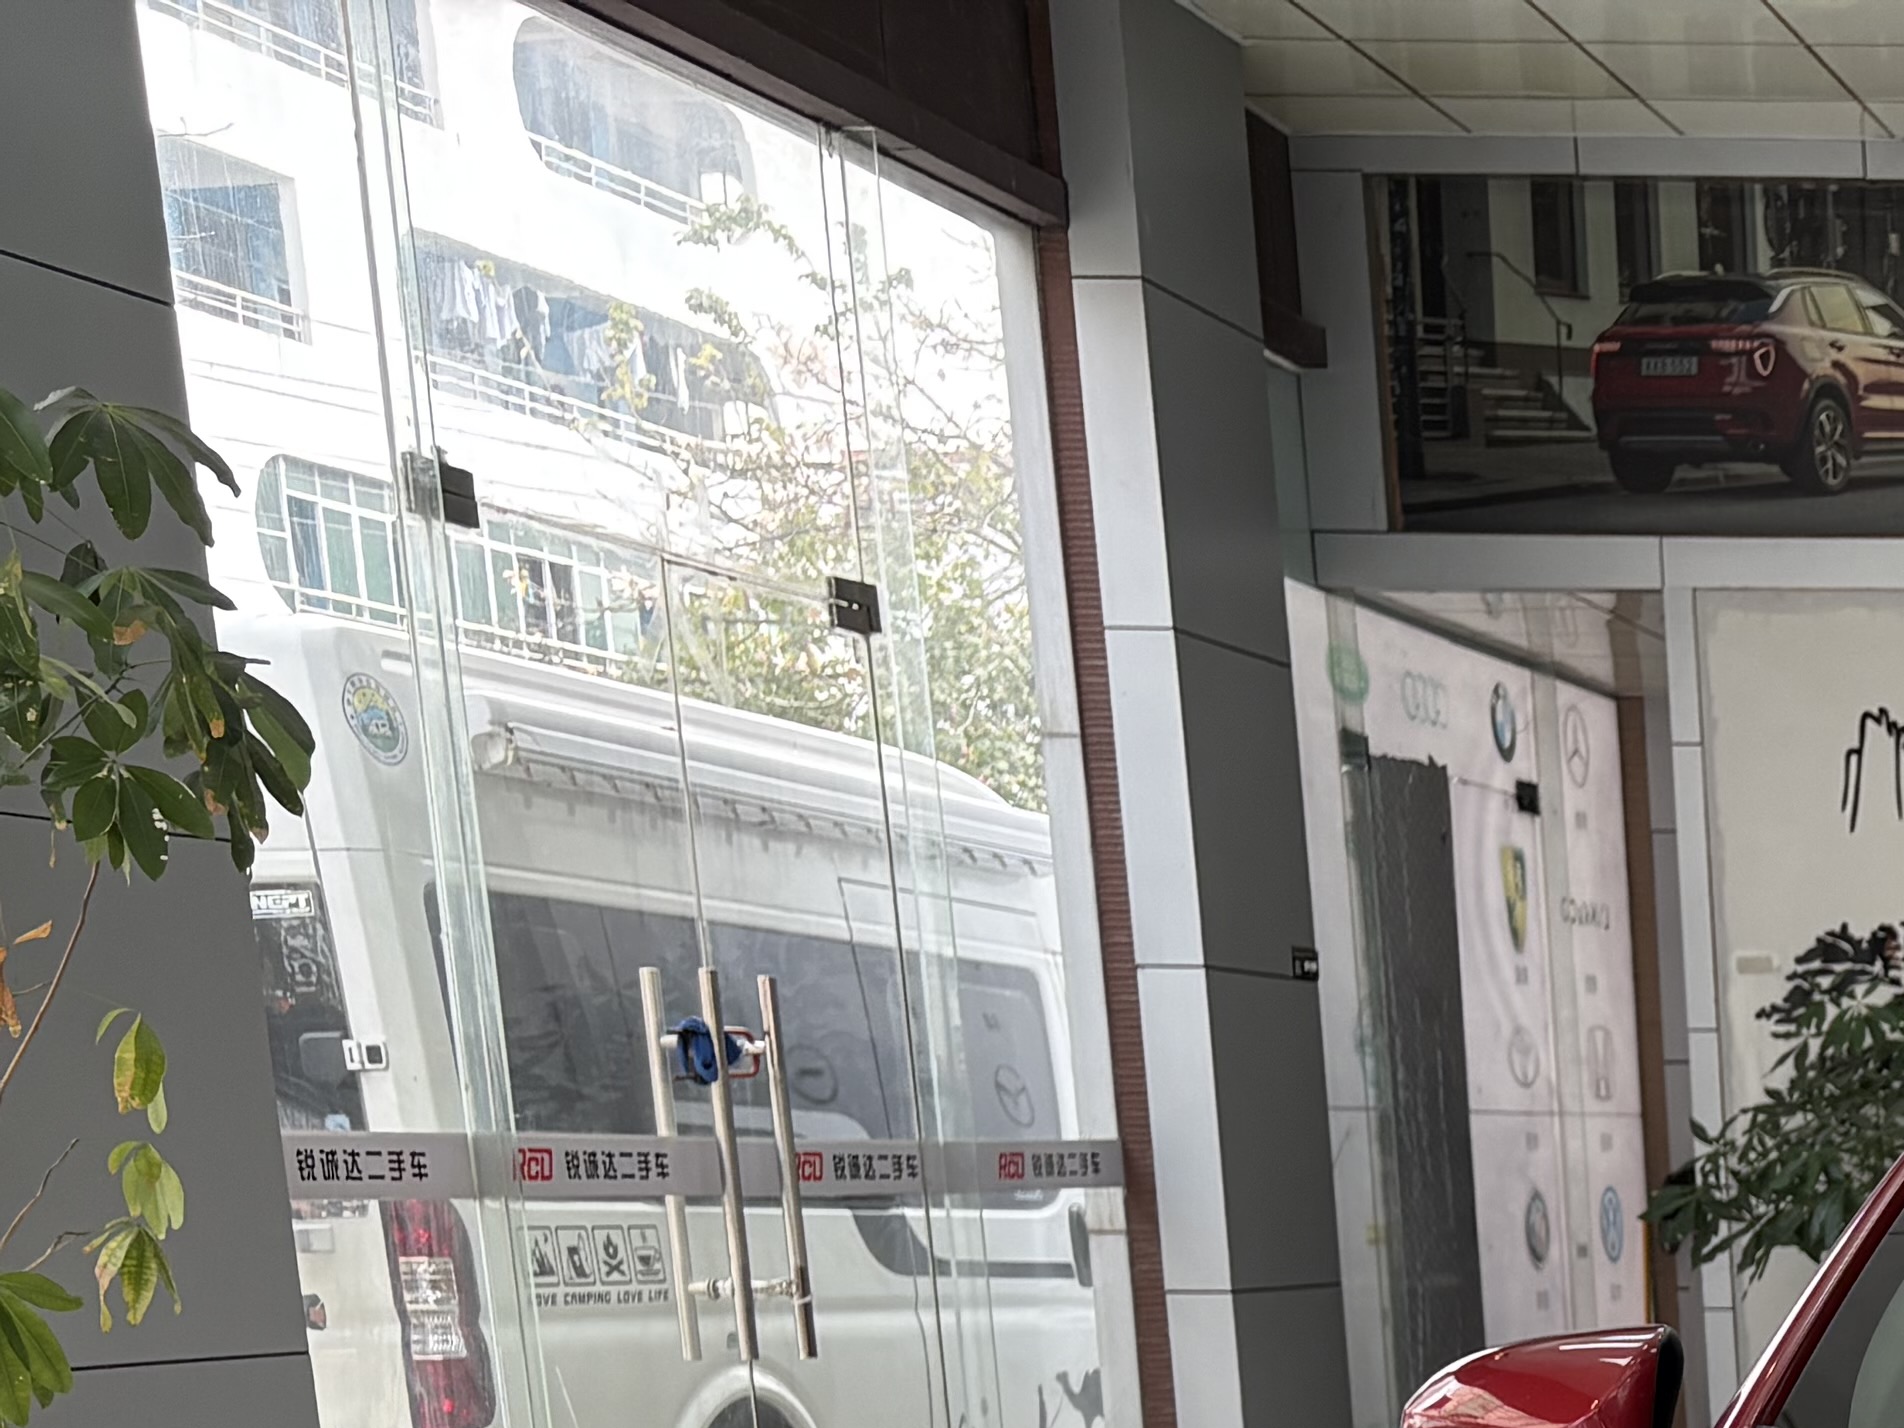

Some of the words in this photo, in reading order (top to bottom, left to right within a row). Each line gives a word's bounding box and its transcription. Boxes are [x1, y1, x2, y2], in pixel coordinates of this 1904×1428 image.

[296, 1149, 429, 1181] 锐诚达二手车
[564, 1151, 670, 1180] 锐诚达二手车
